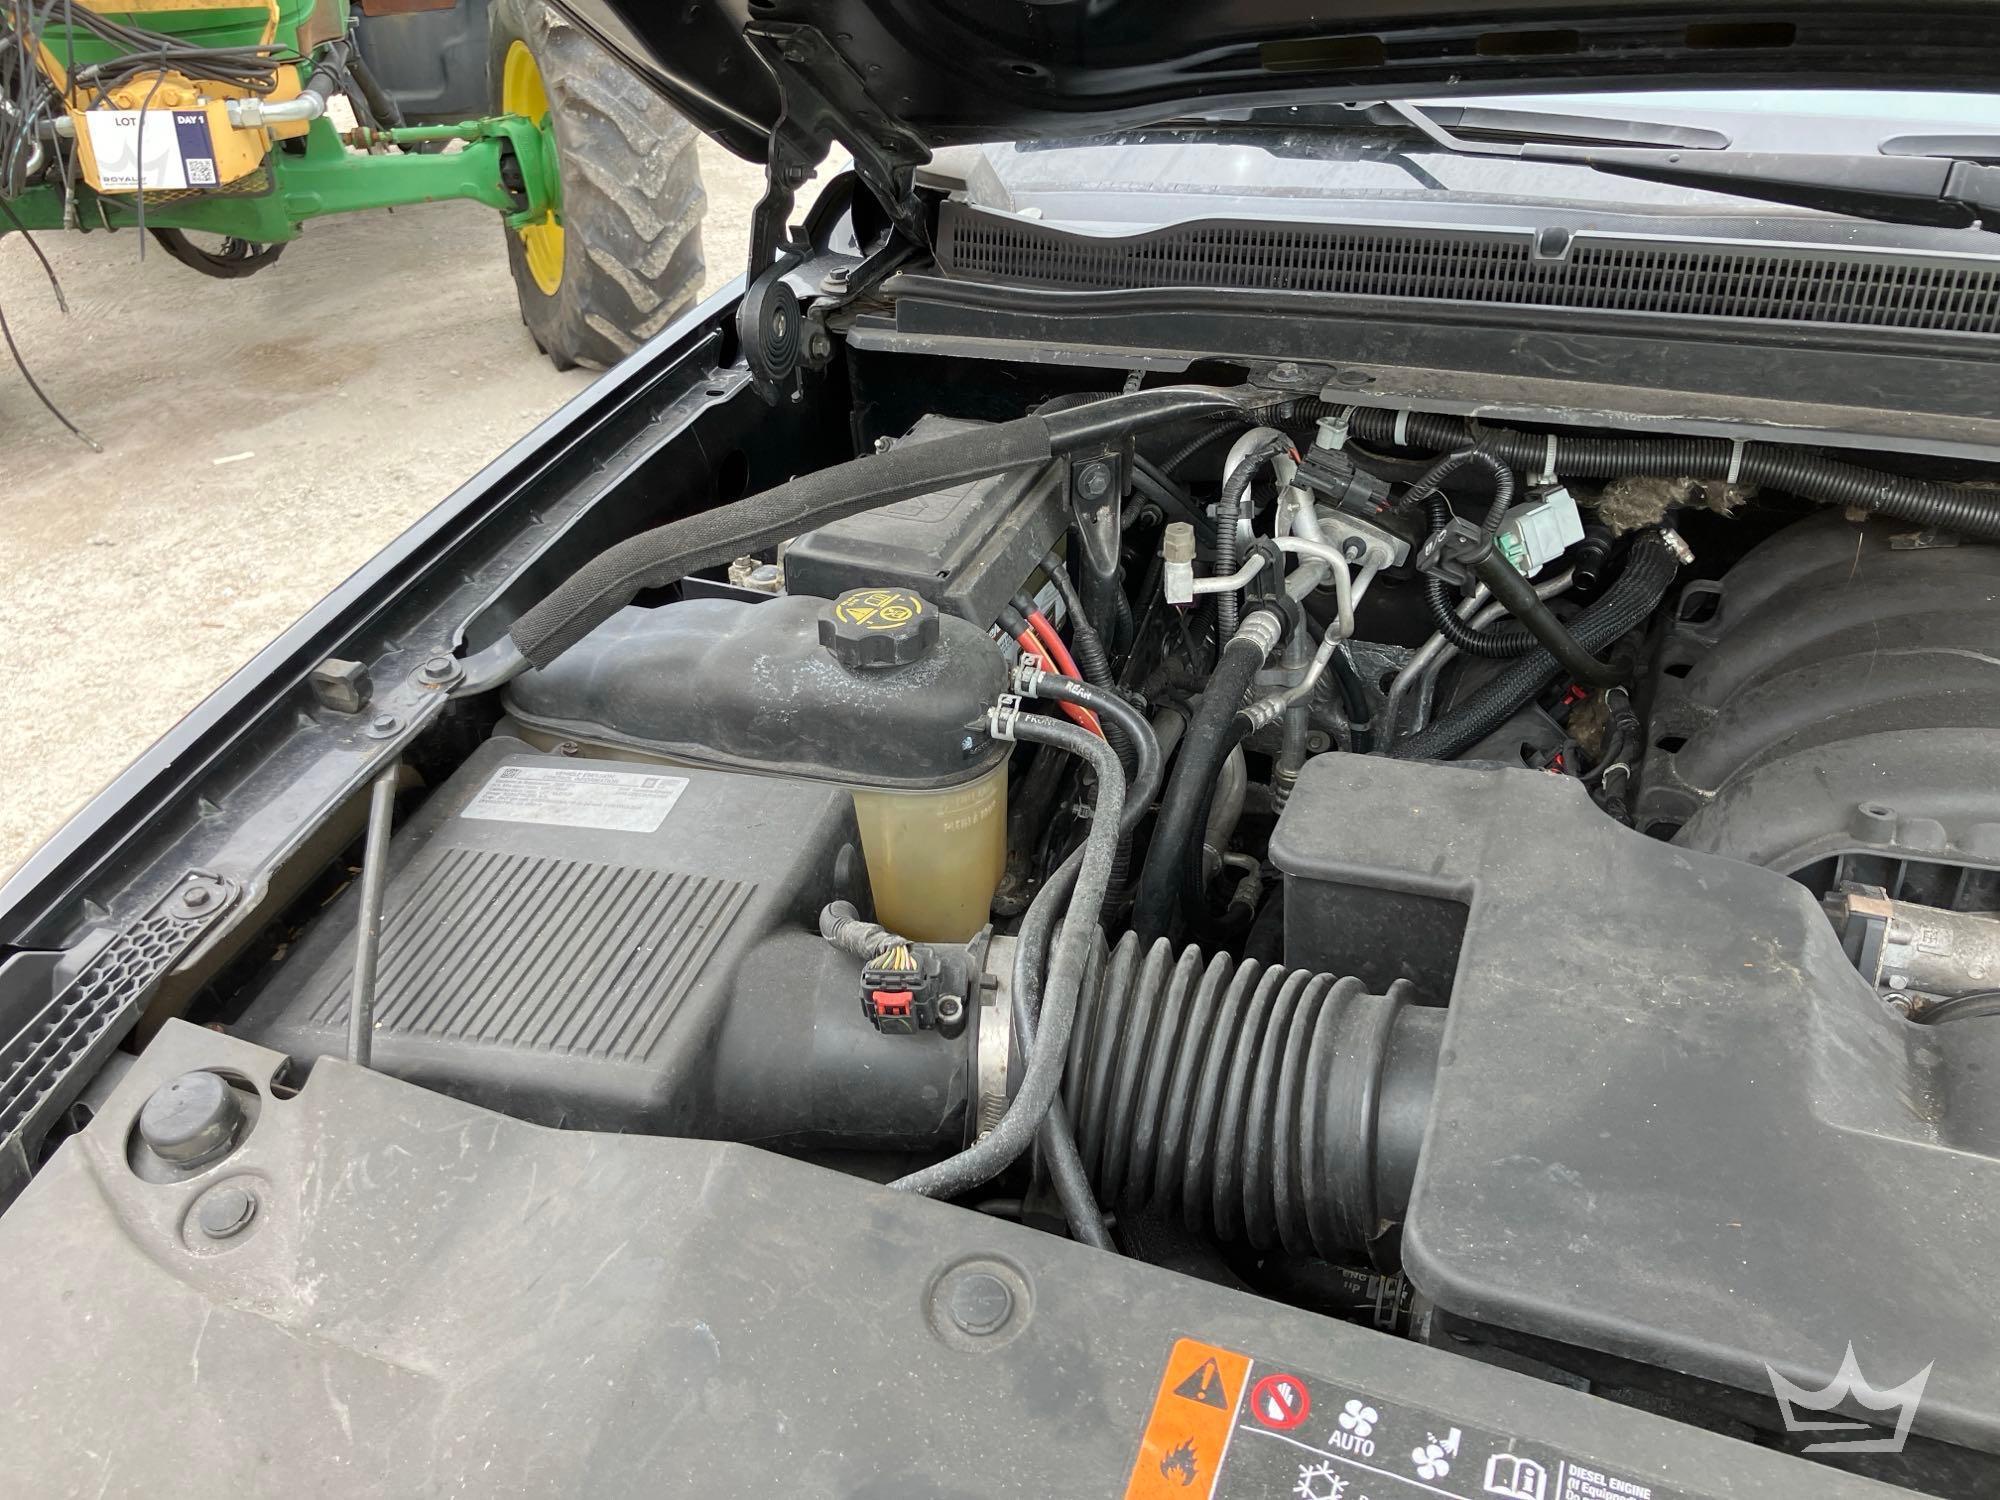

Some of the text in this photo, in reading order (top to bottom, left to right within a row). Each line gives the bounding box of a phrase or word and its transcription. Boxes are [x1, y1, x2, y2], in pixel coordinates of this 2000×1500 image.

[115, 117, 136, 127] LOT
[177, 115, 204, 125] DAY 1
[1328, 1429, 1375, 1457] AUTO
[1568, 1463, 1652, 1500] DIESEL ENGINE
